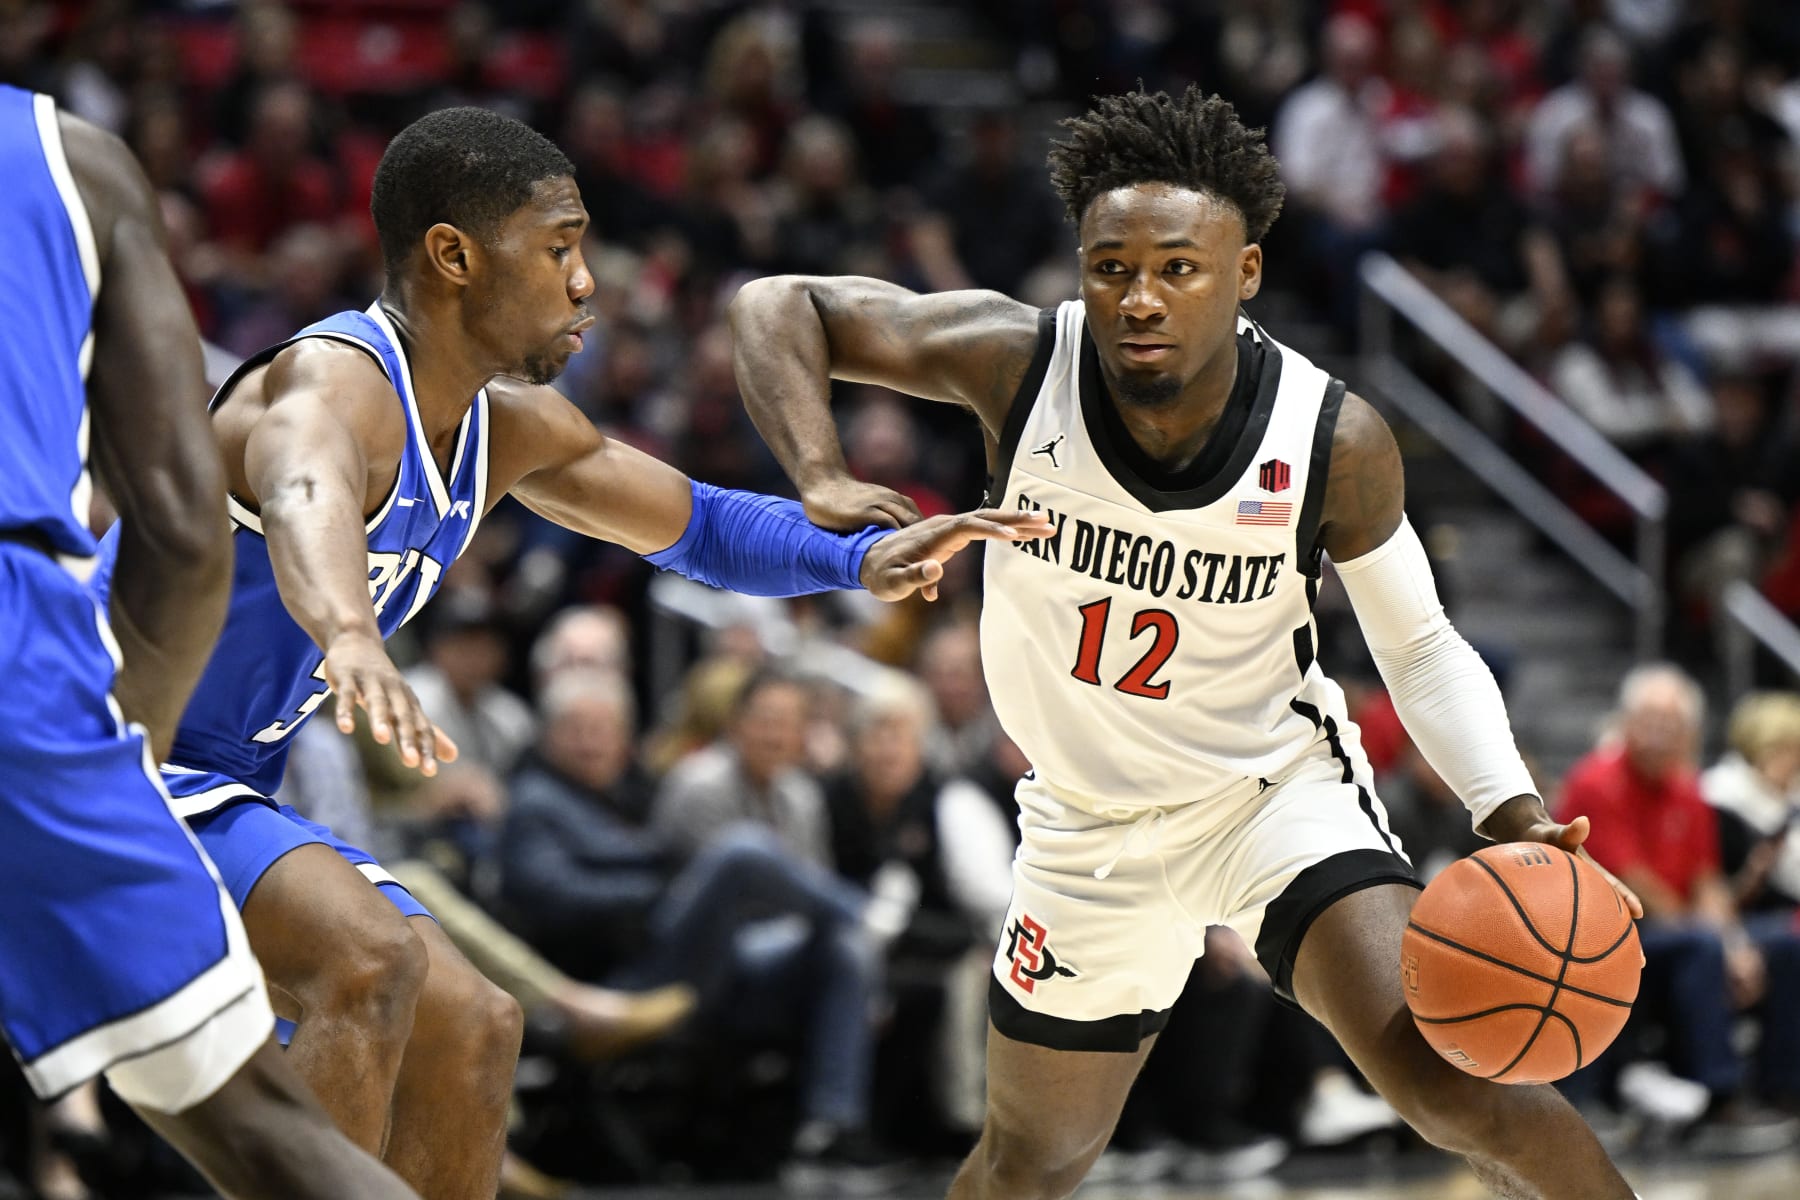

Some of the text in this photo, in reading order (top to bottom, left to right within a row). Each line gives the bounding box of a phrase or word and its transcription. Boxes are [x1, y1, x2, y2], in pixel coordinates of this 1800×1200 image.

[1070, 519, 1176, 598] DIEGO
[1176, 549, 1286, 604] STATE
[1071, 596, 1179, 700] 12
